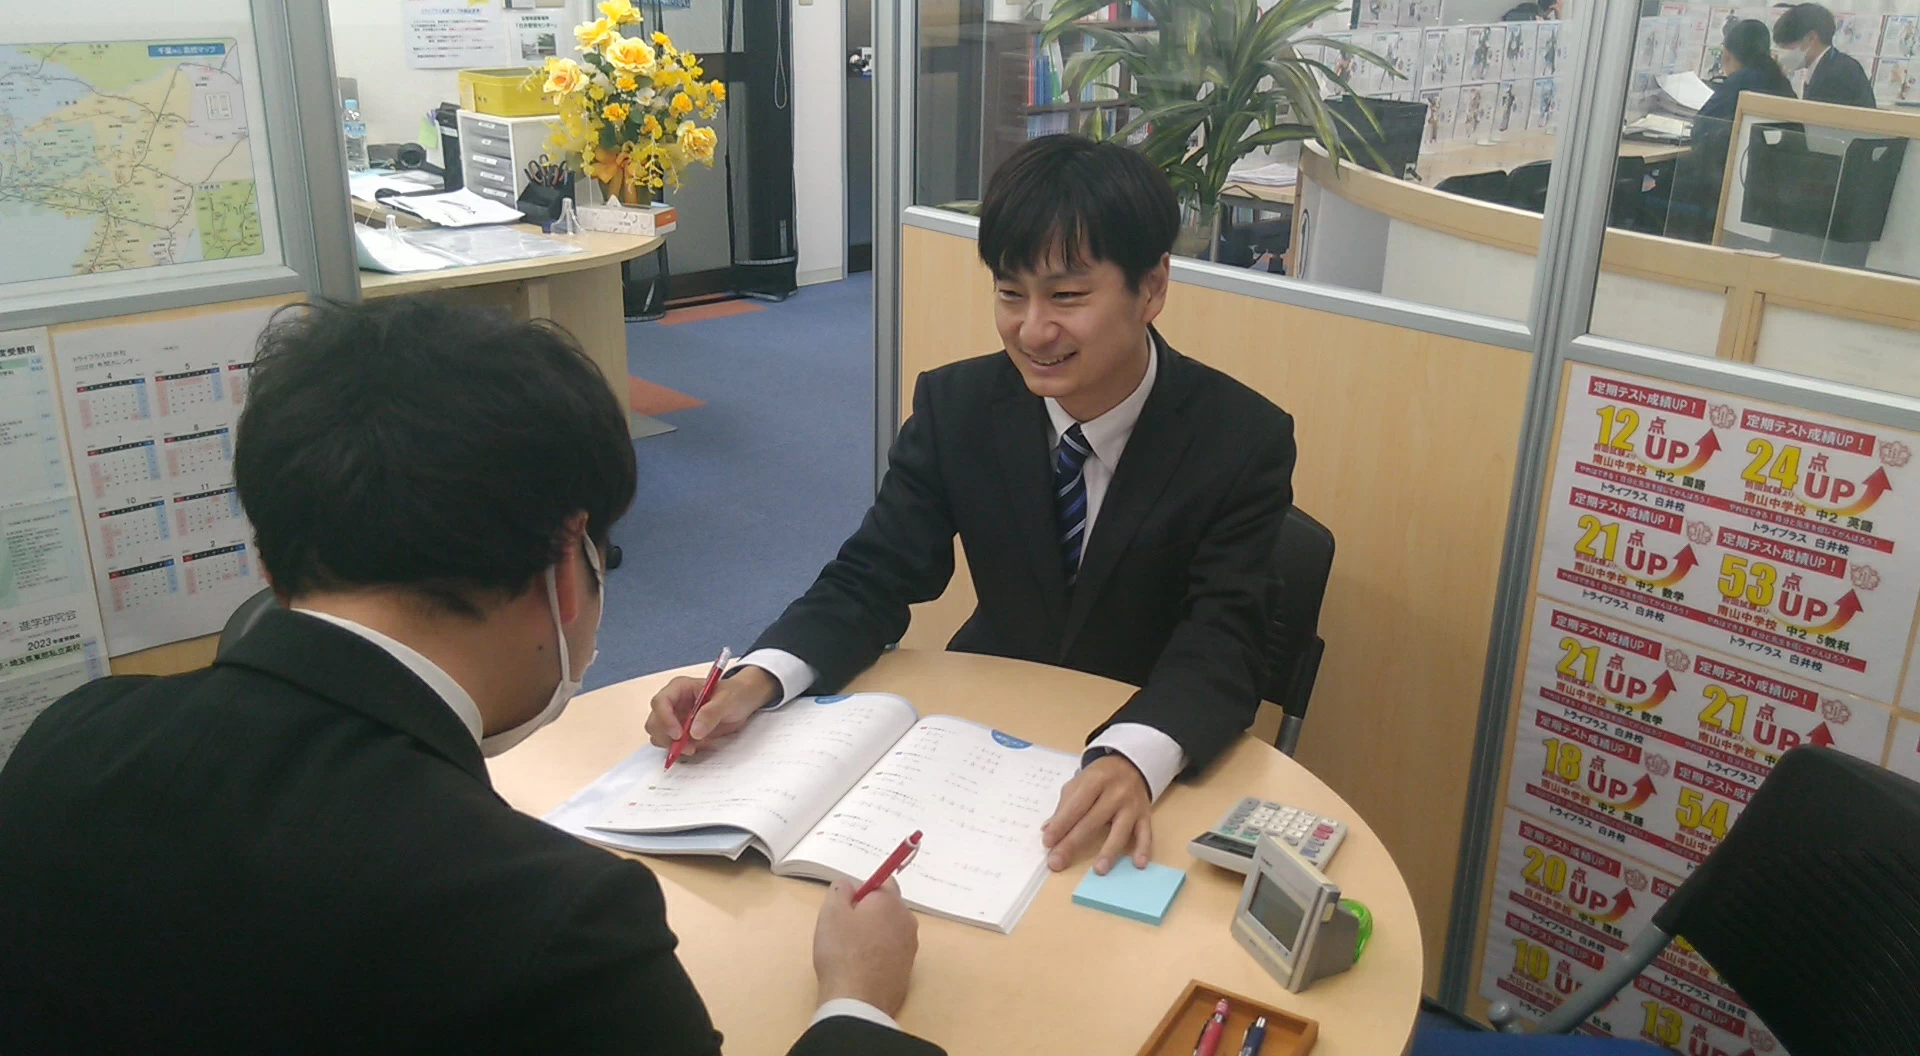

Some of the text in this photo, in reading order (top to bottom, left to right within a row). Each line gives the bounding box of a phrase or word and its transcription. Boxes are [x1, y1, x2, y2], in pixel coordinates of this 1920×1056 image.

[1593, 381, 1697, 413] 定期テスト成績UP！
[1596, 405, 1640, 451] 12
[1648, 416, 1667, 435] 点
[1746, 414, 1865, 451] 定期テスト成績UP！
[1645, 434, 1690, 464] UP
[1741, 437, 1802, 490] 24
[1808, 452, 1829, 473] 点
[1592, 453, 1707, 491] 南山中学校 中2 国語
[1804, 472, 1856, 504] UP
[1575, 492, 1675, 529] 定期テスト成績UP！
[1601, 482, 1686, 513] トライプラス 白井校
[1743, 491, 1874, 533] 南山中学校 中2 英語
[1574, 515, 1619, 561] 21
[1627, 529, 1645, 548] 点
[1722, 532, 1837, 572] 定期テスト成績UP！
[1753, 521, 1850, 556] トライプラス 白井校
[1625, 547, 1668, 576] UP
[1574, 562, 1685, 601] 南山中学校 中2 数学
[1718, 553, 1777, 607] 53
[1782, 572, 1802, 592] 点
[19, 610, 76, 632] 進学研究会
[1583, 589, 1665, 623] トライプラス 白井校
[1778, 590, 1828, 622] UP
[1556, 615, 1653, 654] 定期テスト成績UP！
[1717, 605, 1850, 653] 南山中学校 中2 5教科
[1556, 636, 1600, 684] 21
[1607, 653, 1625, 671] 点
[1730, 635, 1823, 672] トライプラス 白井校
[1604, 669, 1647, 699] UP
[1700, 662, 1807, 705] 定期テスト成績UP！
[1564, 708, 1608, 732] トライプラス
[1614, 728, 1644, 745] 白井校
[1614, 702, 1634, 716] 中2
[1641, 711, 1664, 726] 数学
[1698, 684, 1749, 734] 21
[1756, 703, 1776, 722] 点
[1540, 715, 1633, 758] 定期テスト成績UP！
[1753, 720, 1801, 751] UP
[1543, 737, 1582, 781] 18
[1589, 755, 1606, 772] 点
[1707, 760, 1757, 785] トライプラス
[1588, 770, 1628, 799] UP
[1550, 805, 1593, 829] トライプラス
[1598, 826, 1626, 843] 白井校
[1598, 802, 1616, 816] 中2
[1675, 787, 1729, 840] 54
[1521, 845, 1567, 893] 20
[1572, 867, 1588, 885] 点
[1569, 882, 1608, 911] UP
[1531, 913, 1573, 938] トライプラス
[1512, 938, 1549, 981] 10
[1664, 975, 1711, 1001] トライプラス
[1717, 999, 1748, 1019] 白井校
[1641, 1001, 1683, 1046] 13
